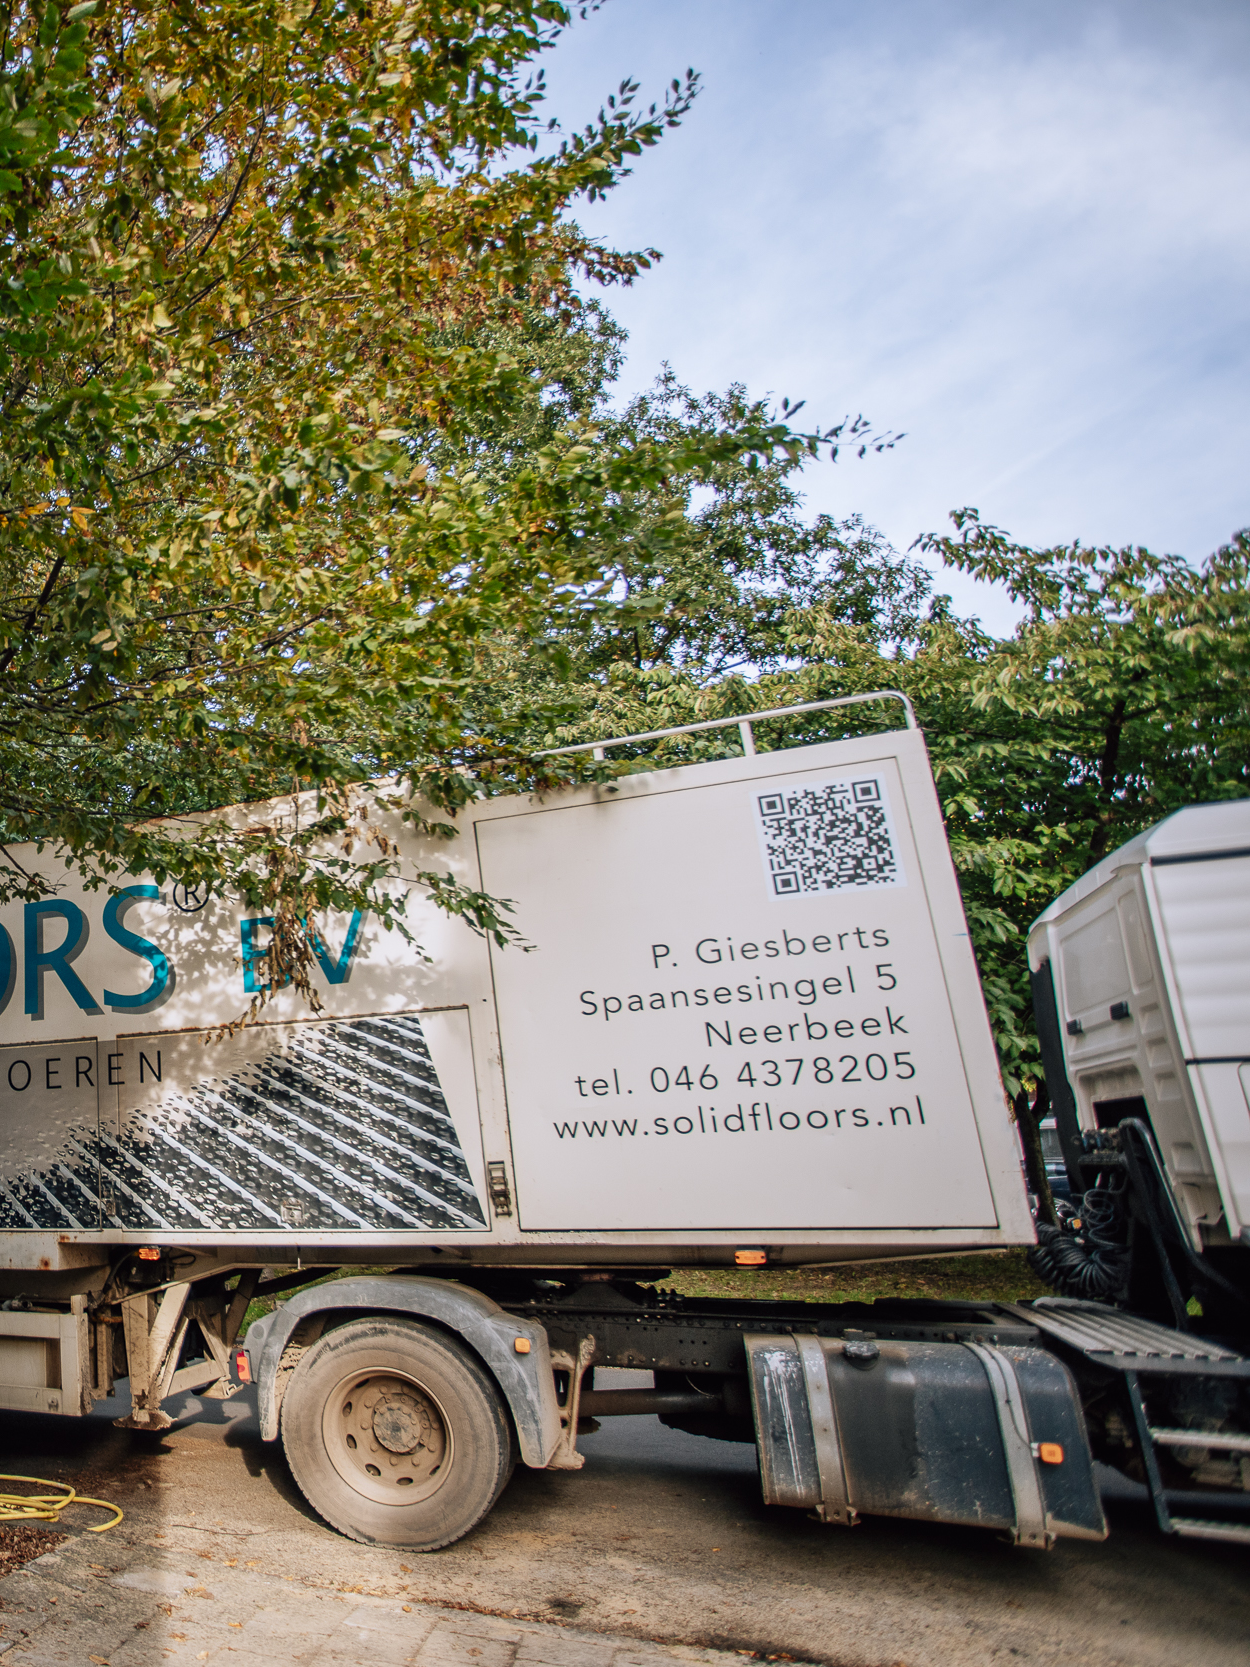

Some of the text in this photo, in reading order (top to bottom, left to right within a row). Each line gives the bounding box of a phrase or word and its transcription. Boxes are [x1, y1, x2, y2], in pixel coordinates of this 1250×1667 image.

[651, 925, 891, 969] P. Giesberts
[579, 963, 898, 1022] Spaansesingel 5
[705, 1006, 909, 1047] Neerbeek
[574, 1051, 916, 1098] tel. 046 4378205
[553, 1094, 927, 1140] www.solidfloors.nl
